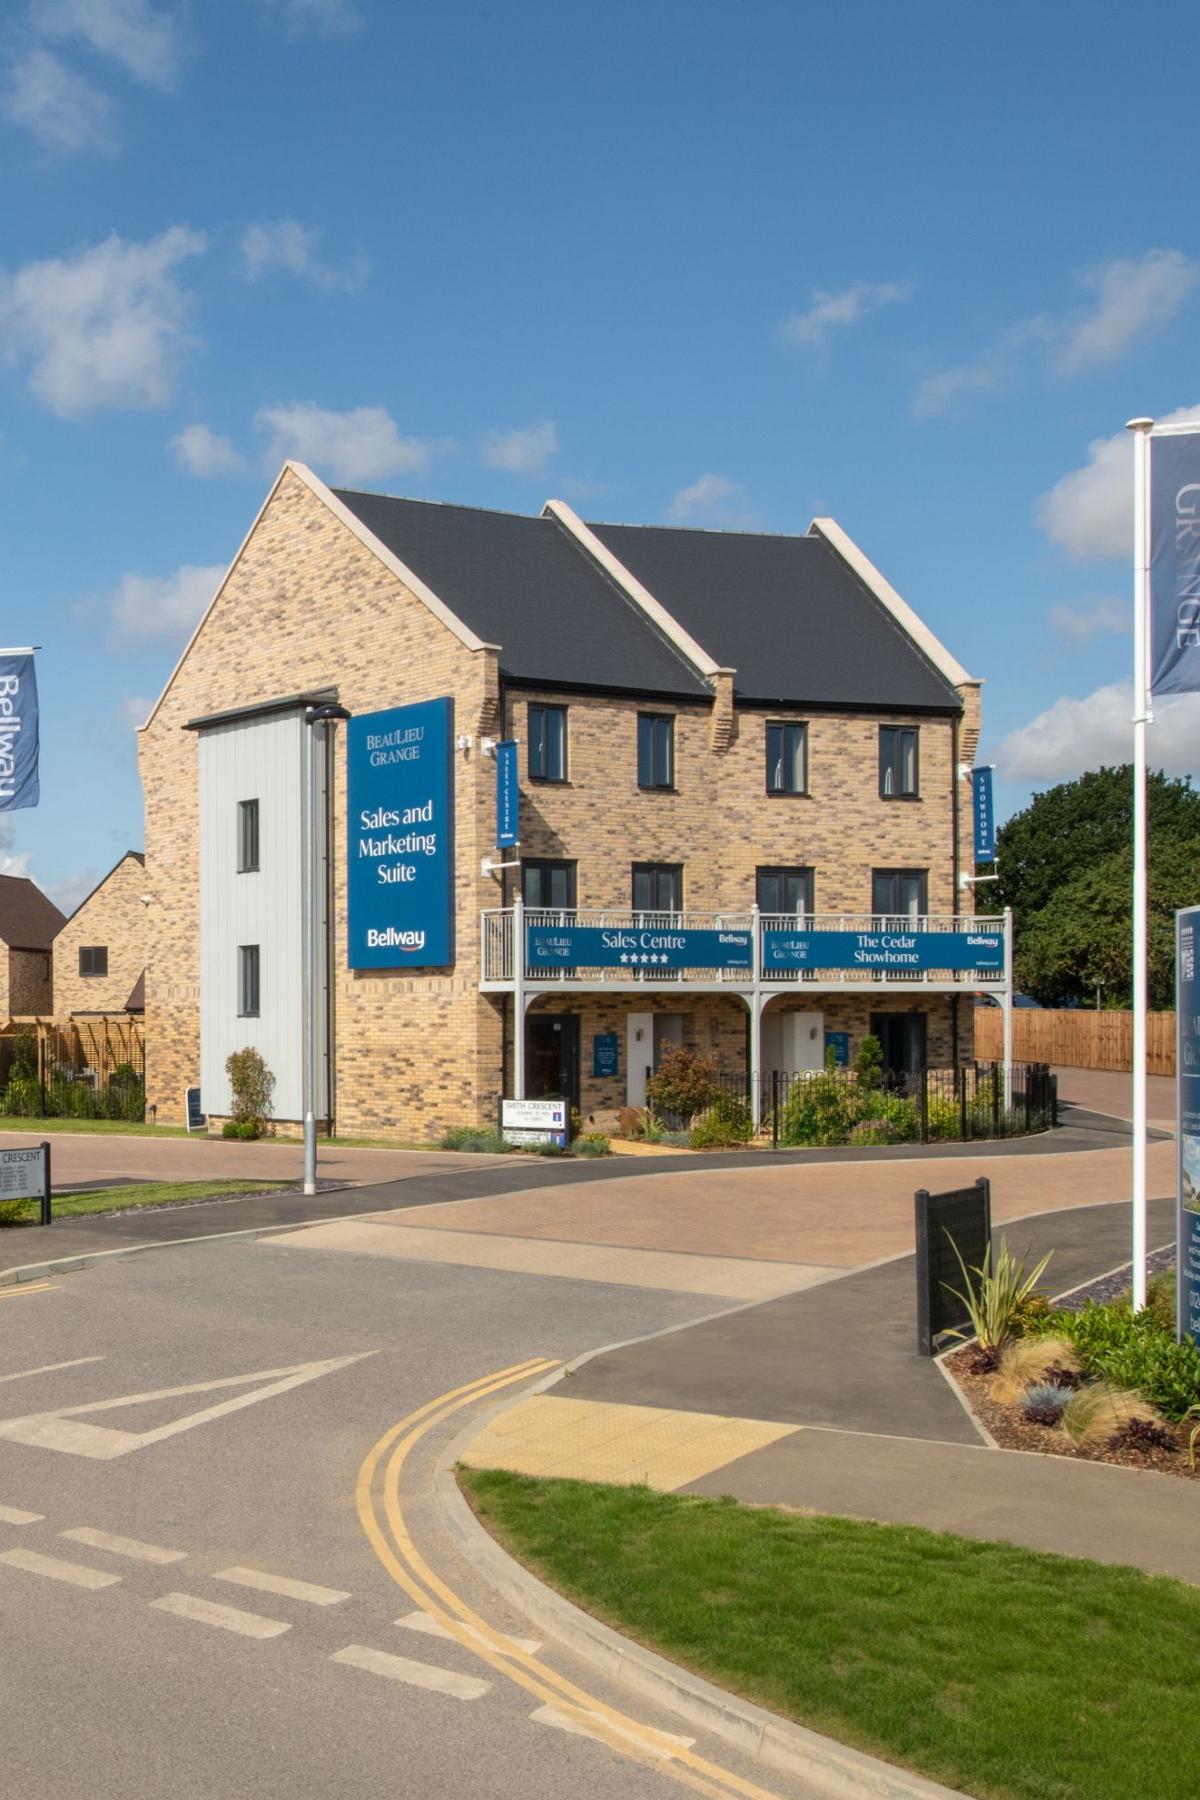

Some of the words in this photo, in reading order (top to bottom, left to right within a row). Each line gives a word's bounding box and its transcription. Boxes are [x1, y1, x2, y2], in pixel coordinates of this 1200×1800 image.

[366, 727, 424, 750] BEAULIEU
[370, 745, 420, 767] GRANGE
[360, 806, 400, 830] Sales
[402, 800, 433, 825] and
[979, 776, 988, 847] SHOWHOME
[358, 833, 436, 858] Marketing
[377, 864, 416, 884] Suite
[367, 927, 425, 950] Bellway
[602, 931, 637, 949] Sales
[640, 933, 686, 950] Centre
[719, 934, 748, 946] Bellway
[857, 935, 879, 948] The
[881, 936, 917, 948] Cedar
[967, 936, 999, 947] Bellway
[537, 947, 570, 956] GRNGE
[773, 950, 807, 959] GRNGE
[854, 950, 919, 963] Showhome
[3, 1151, 41, 1164] CRESCENT
